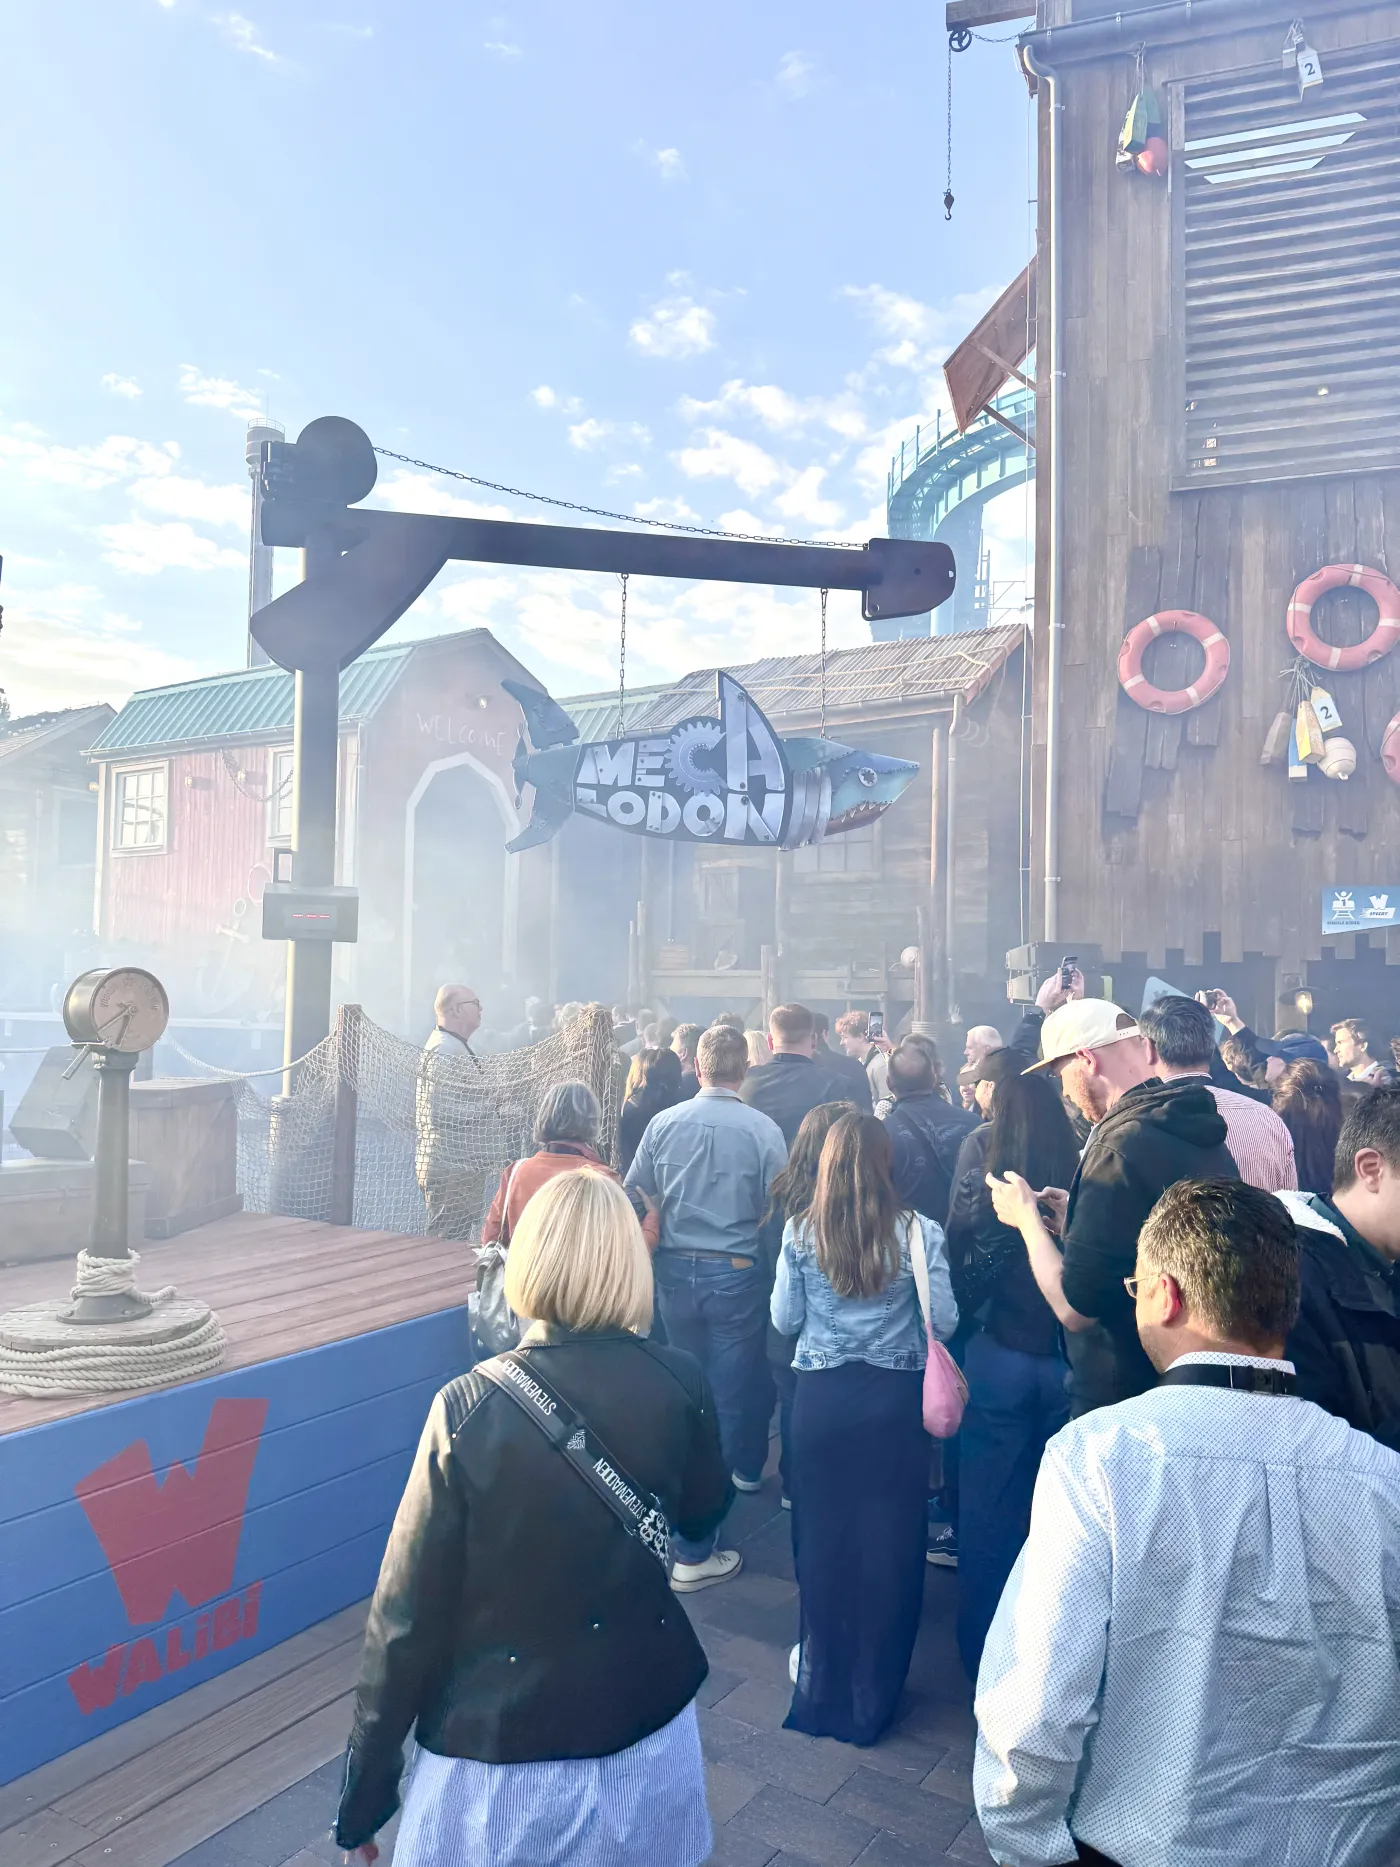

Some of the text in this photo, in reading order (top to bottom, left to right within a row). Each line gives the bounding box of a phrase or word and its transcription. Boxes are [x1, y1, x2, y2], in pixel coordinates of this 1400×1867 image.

[1304, 62, 1316, 76] 2
[416, 712, 506, 756] WELCOME
[1320, 705, 1332, 720] 2
[592, 1457, 647, 1519] STEVEMADDEN
[73, 1397, 271, 1627] W
